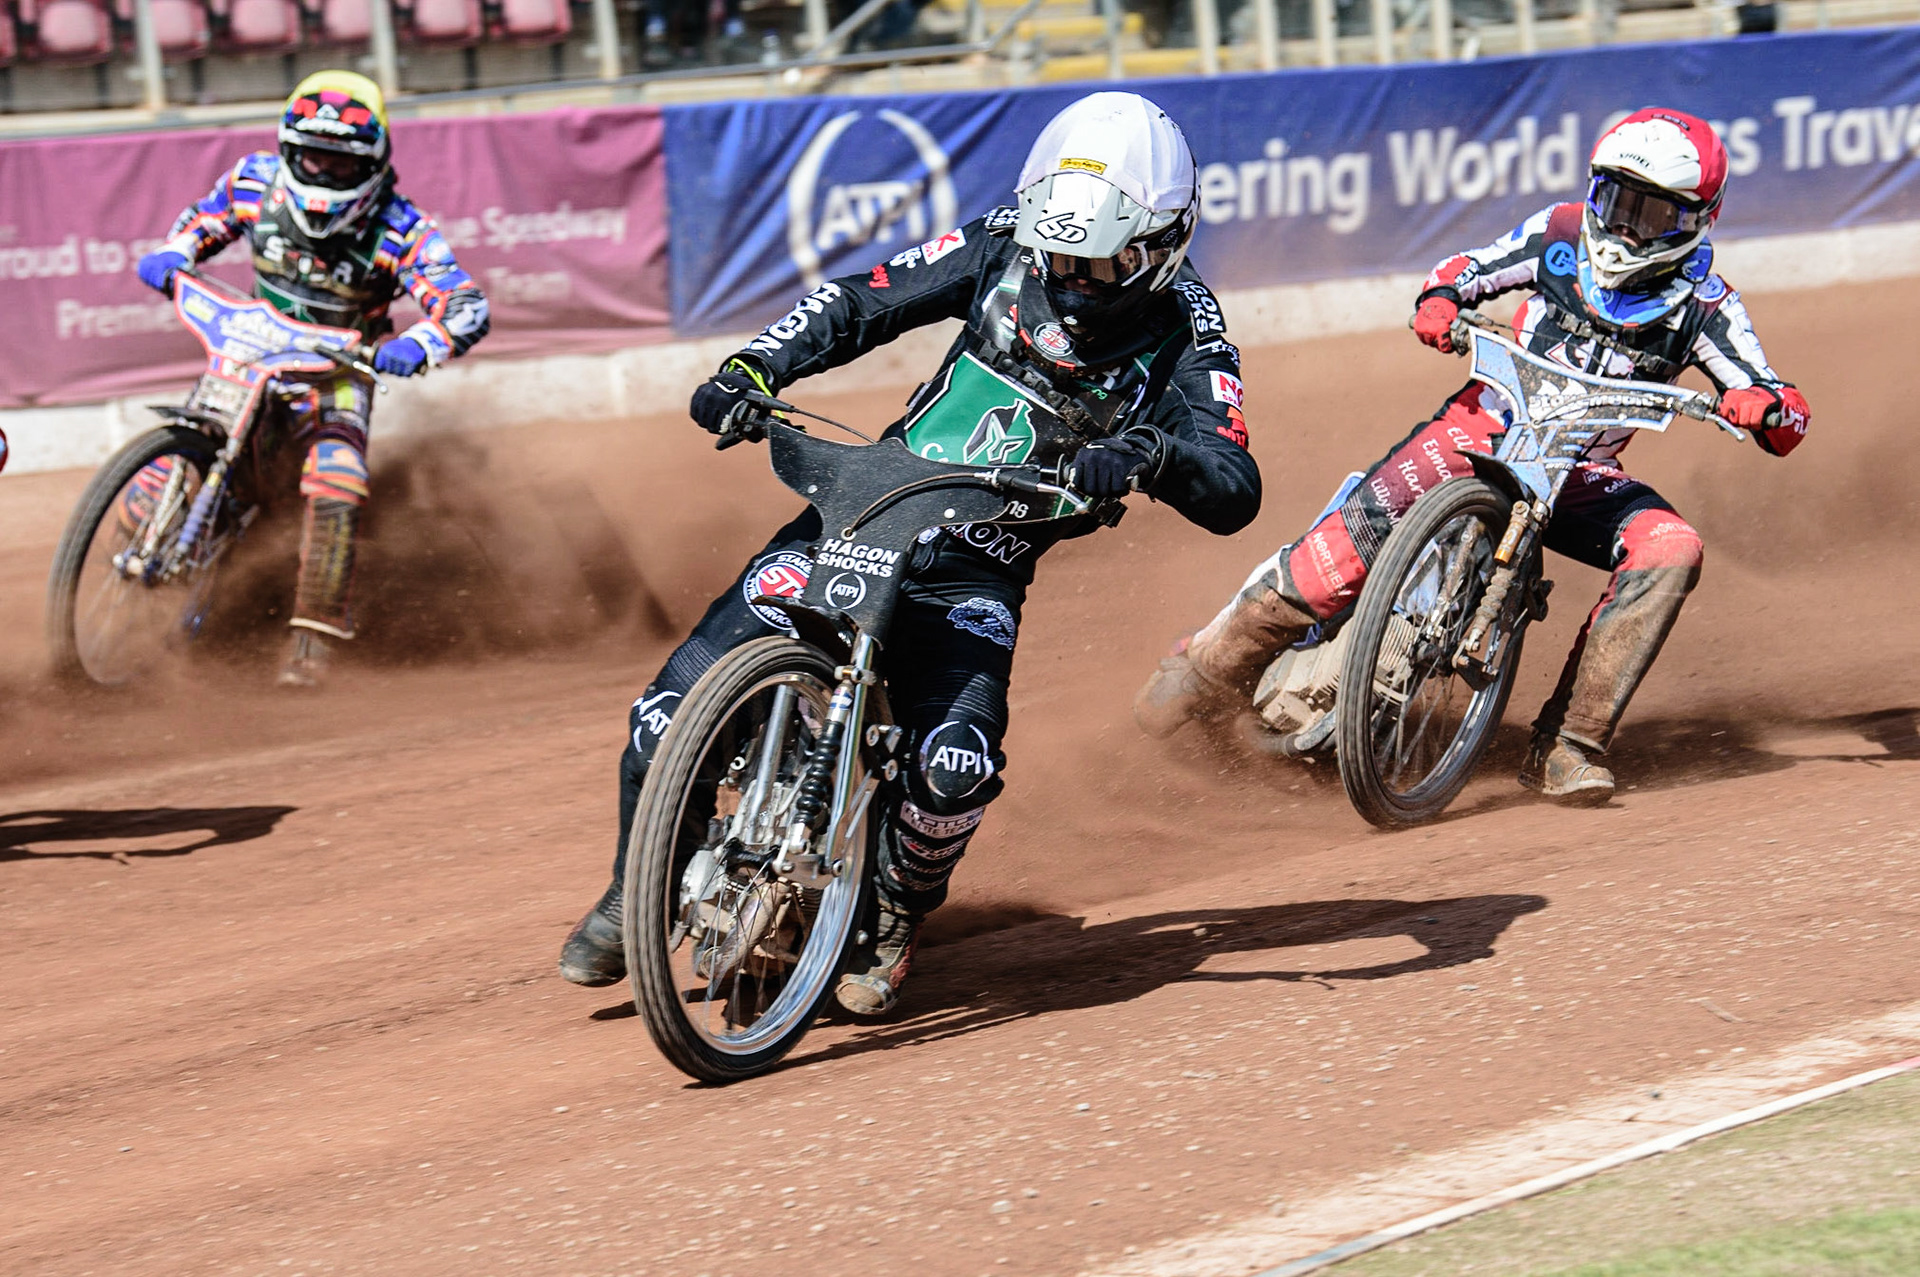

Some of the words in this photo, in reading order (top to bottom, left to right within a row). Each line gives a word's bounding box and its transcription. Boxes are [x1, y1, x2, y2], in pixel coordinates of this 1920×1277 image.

[1199, 138, 1372, 234] ering
[1386, 113, 1580, 208] World
[481, 202, 627, 253] Speedway
[1034, 212, 1088, 244] 6D
[0, 234, 79, 281] roud
[83, 237, 126, 274] to
[486, 266, 571, 304] Team
[1182, 280, 1224, 332] GON
[56, 297, 183, 341] Premie
[748, 282, 841, 357] HAGON
[1171, 283, 1209, 333] OCKS
[1398, 459, 1425, 500] Har
[1422, 439, 1453, 482] Esma
[1371, 477, 1401, 528] Lilly-M
[816, 552, 895, 578] SHOCKS
[821, 538, 901, 565] HAGON
[831, 583, 861, 599] ATPI
[640, 708, 673, 741] AT
[929, 745, 982, 775] ATPI
